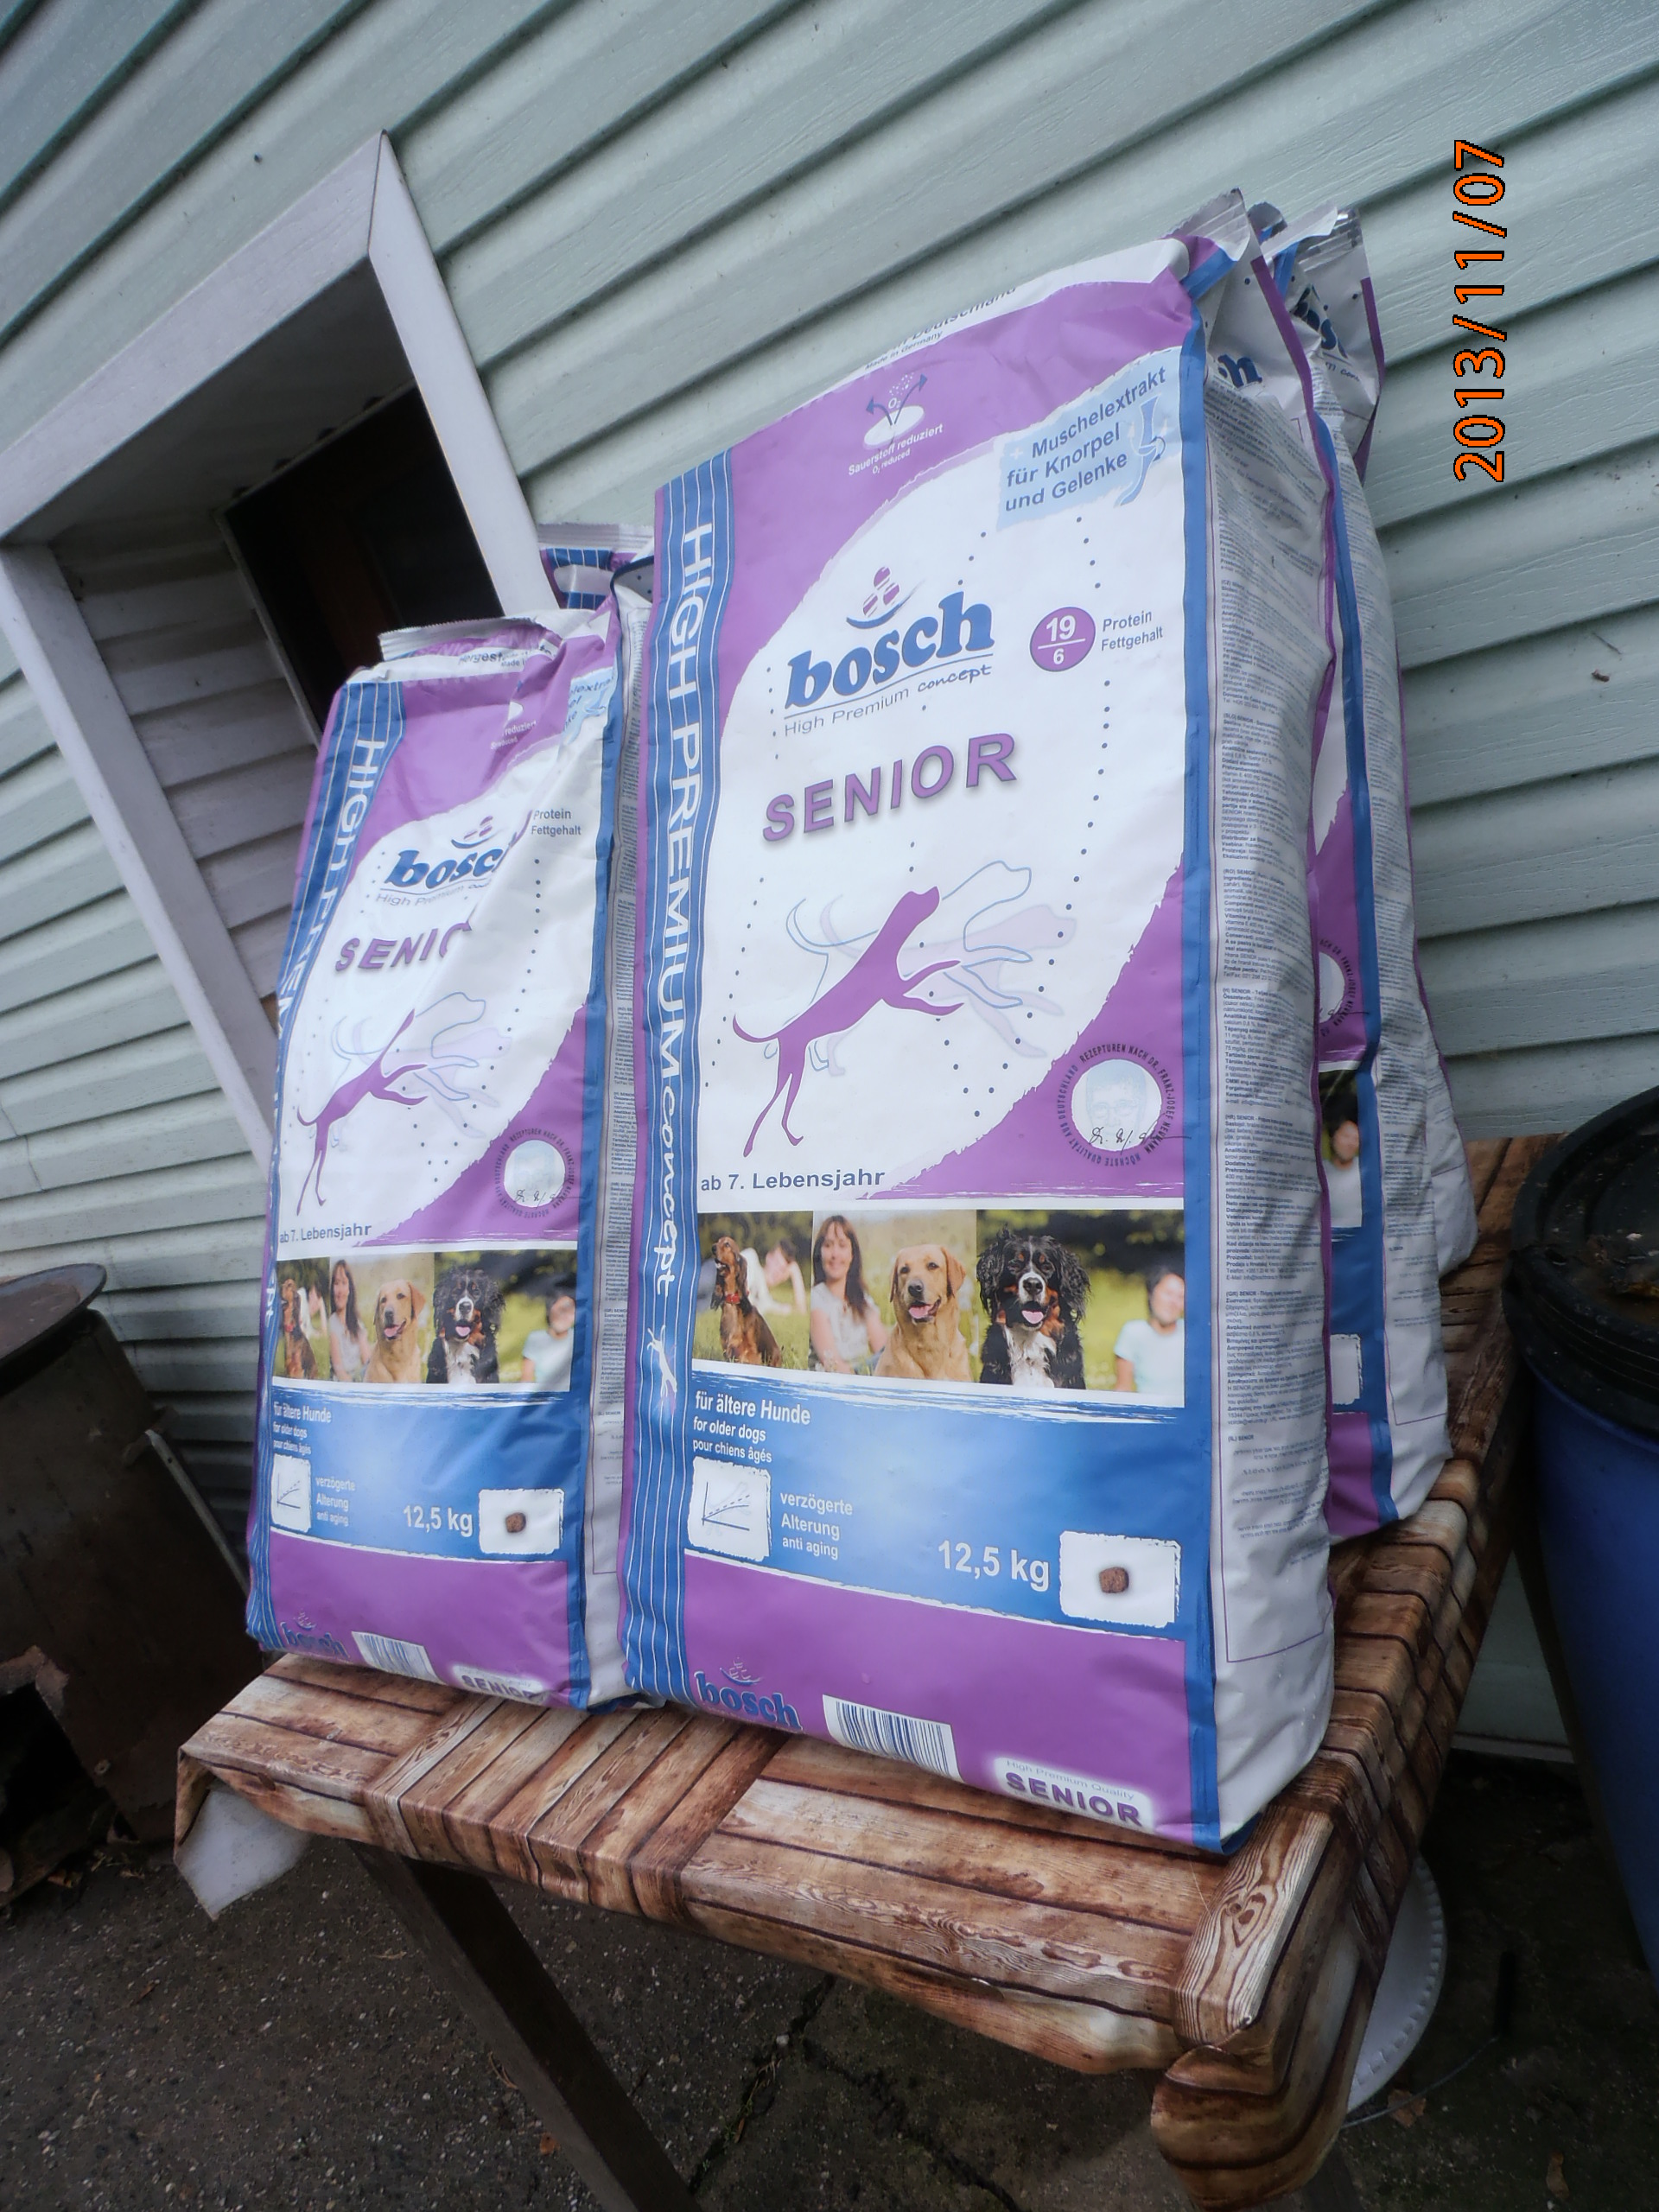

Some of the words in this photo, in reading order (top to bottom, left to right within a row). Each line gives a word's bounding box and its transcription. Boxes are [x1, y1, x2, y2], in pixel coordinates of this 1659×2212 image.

[1032, 365, 1166, 459] Muschelextrakt
[849, 442, 895, 476] Sauerstoff
[897, 423, 944, 451] reduziert
[1007, 467, 1039, 487] für
[1046, 422, 1121, 478] Knorpel
[1006, 487, 1045, 512] und
[1052, 453, 1128, 499] Gelenke
[668, 524, 713, 709] HIGH
[1046, 613, 1076, 643] 19
[1102, 610, 1153, 632] Protein
[785, 591, 995, 710] bosch
[1053, 648, 1065, 665] 6
[1101, 626, 1164, 652] Fettgehalt
[785, 715, 824, 737] High
[832, 687, 909, 725] Premium
[917, 663, 993, 692] concept
[764, 733, 1017, 842] SENIOR
[531, 825, 582, 837] Fettgehalt
[533, 808, 572, 820] Protein
[385, 849, 505, 889] bosc
[376, 893, 410, 906] High
[658, 728, 701, 1077] PREMIUM
[335, 919, 472, 972] SENI
[1079, 1044, 1126, 1064] REZEPTUREN
[1128, 1045, 1149, 1060] NACH
[1158, 1068, 1176, 1120] FRANZ-JOSEF
[653, 1085, 677, 1297] concept
[701, 1174, 721, 1192] ab
[728, 1173, 745, 1190] 7.
[753, 1168, 886, 1192] Lebensjahr
[280, 1230, 289, 1243] ab
[301, 1223, 372, 1241] Lebensjahr
[302, 1405, 332, 1423] Hunde
[695, 1390, 713, 1411] für
[715, 1393, 756, 1418] ältere
[760, 1399, 811, 1426] Hunde
[693, 1416, 707, 1432] for
[709, 1420, 736, 1437] older
[738, 1424, 766, 1444] dogs
[692, 1439, 713, 1453] pour
[715, 1440, 746, 1459] chiens
[747, 1446, 772, 1465] âgés
[315, 1475, 356, 1492] verzögerte
[316, 1492, 349, 1512] Alterung
[780, 1491, 853, 1516] verzögerte
[404, 1504, 442, 1533] 12,5
[448, 1508, 474, 1538] kg
[781, 1512, 841, 1541] Alterung
[782, 1535, 804, 1551] anti
[806, 1541, 839, 1560] aging
[938, 1540, 1000, 1580] 12,5
[1010, 1549, 1050, 1592] kg
[694, 1671, 804, 1731] bosch
[1007, 1760, 1033, 1772] High
[1036, 1767, 1088, 1789] Premium
[1091, 1782, 1135, 1800] Quality
[1006, 1771, 1142, 1827] SENIOR
